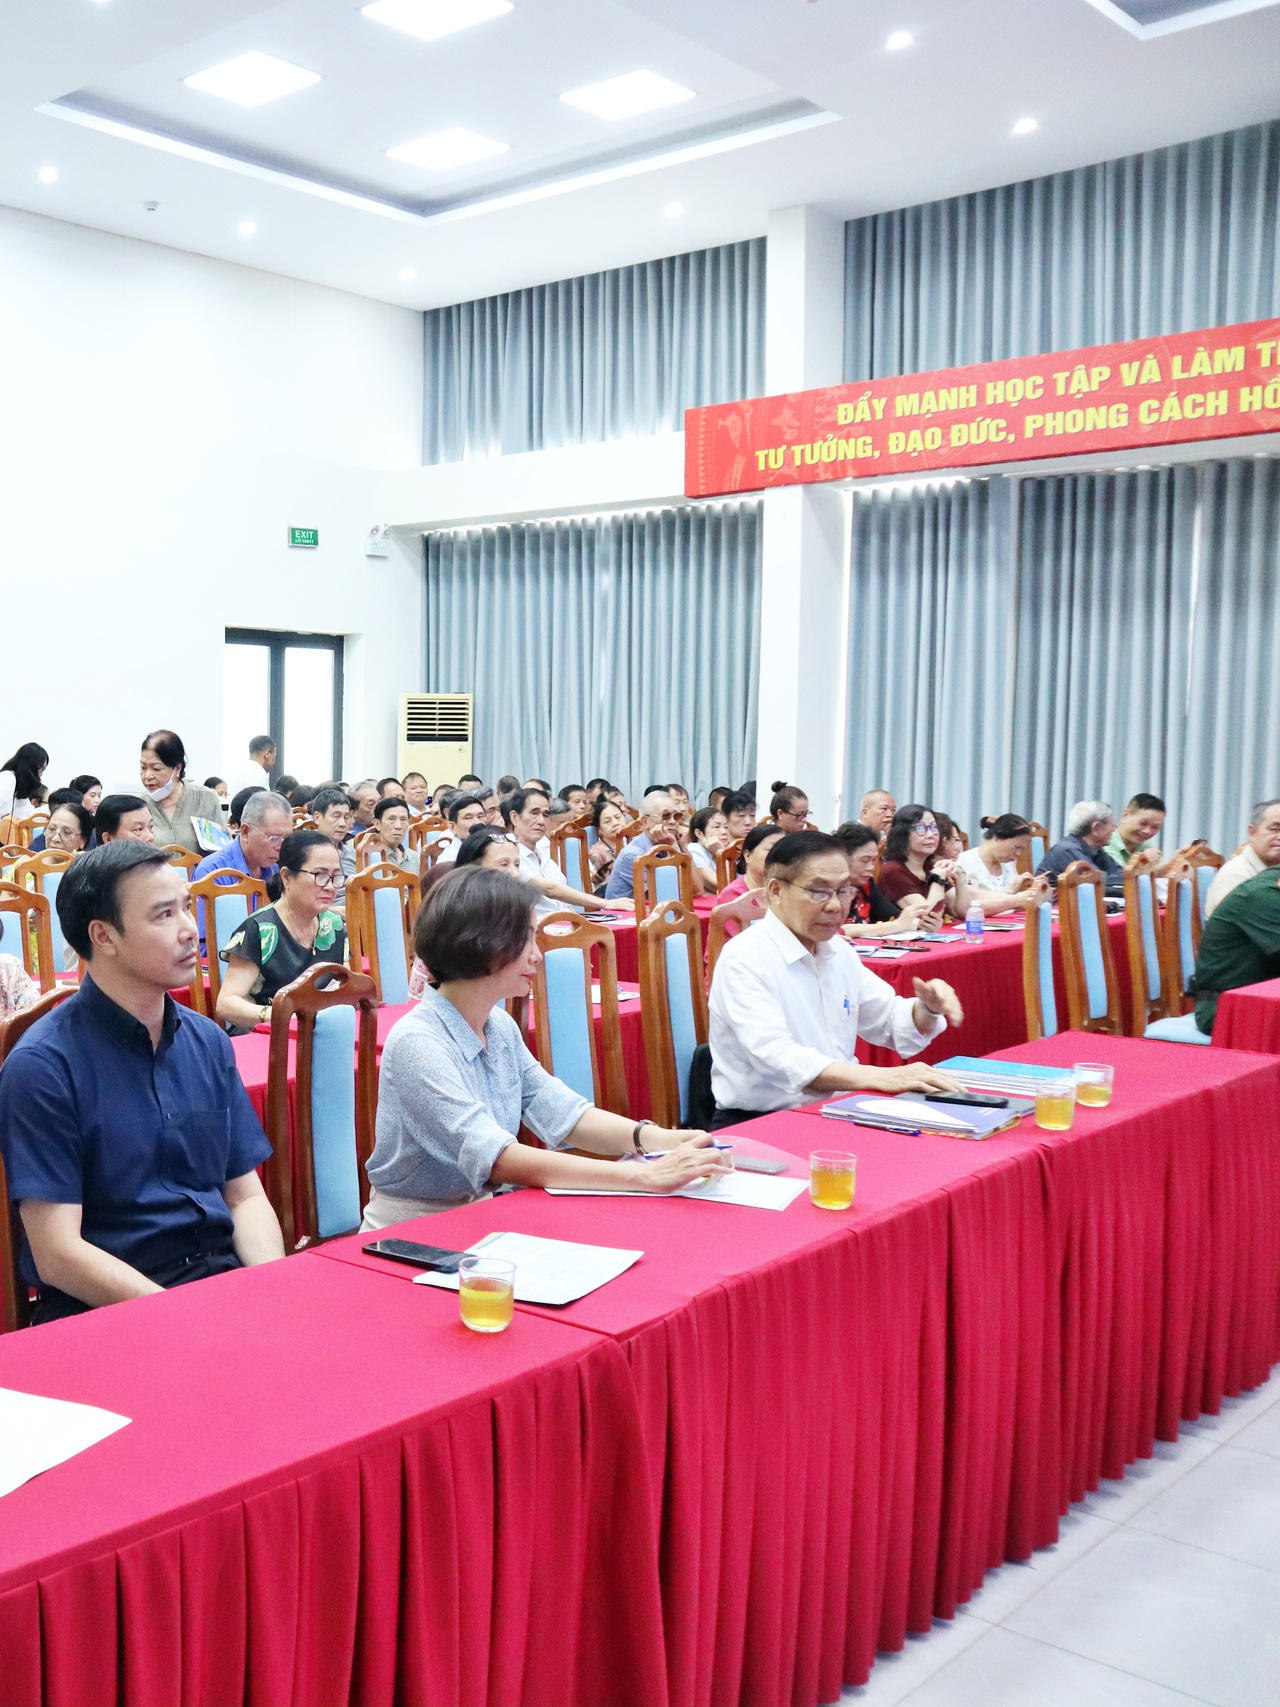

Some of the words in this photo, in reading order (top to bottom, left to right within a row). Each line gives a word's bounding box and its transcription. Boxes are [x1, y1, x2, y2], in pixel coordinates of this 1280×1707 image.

[837, 391, 887, 426] ĐẨY
[895, 385, 978, 418] MẠNH
[985, 375, 1045, 408] HỌC
[1052, 364, 1112, 399] TẬP
[1120, 353, 1162, 387] VÀ
[1171, 346, 1246, 380] LÀM
[1256, 340, 1280, 368] T
[755, 444, 788, 471] TƯ
[791, 433, 881, 467] TƯỞNG,
[888, 426, 942, 457] ĐẠO
[950, 416, 1016, 447] ĐỨC,
[1024, 403, 1129, 439] PHONG
[1138, 391, 1228, 425] CÁCH
[295, 530, 314, 539] EXIT
